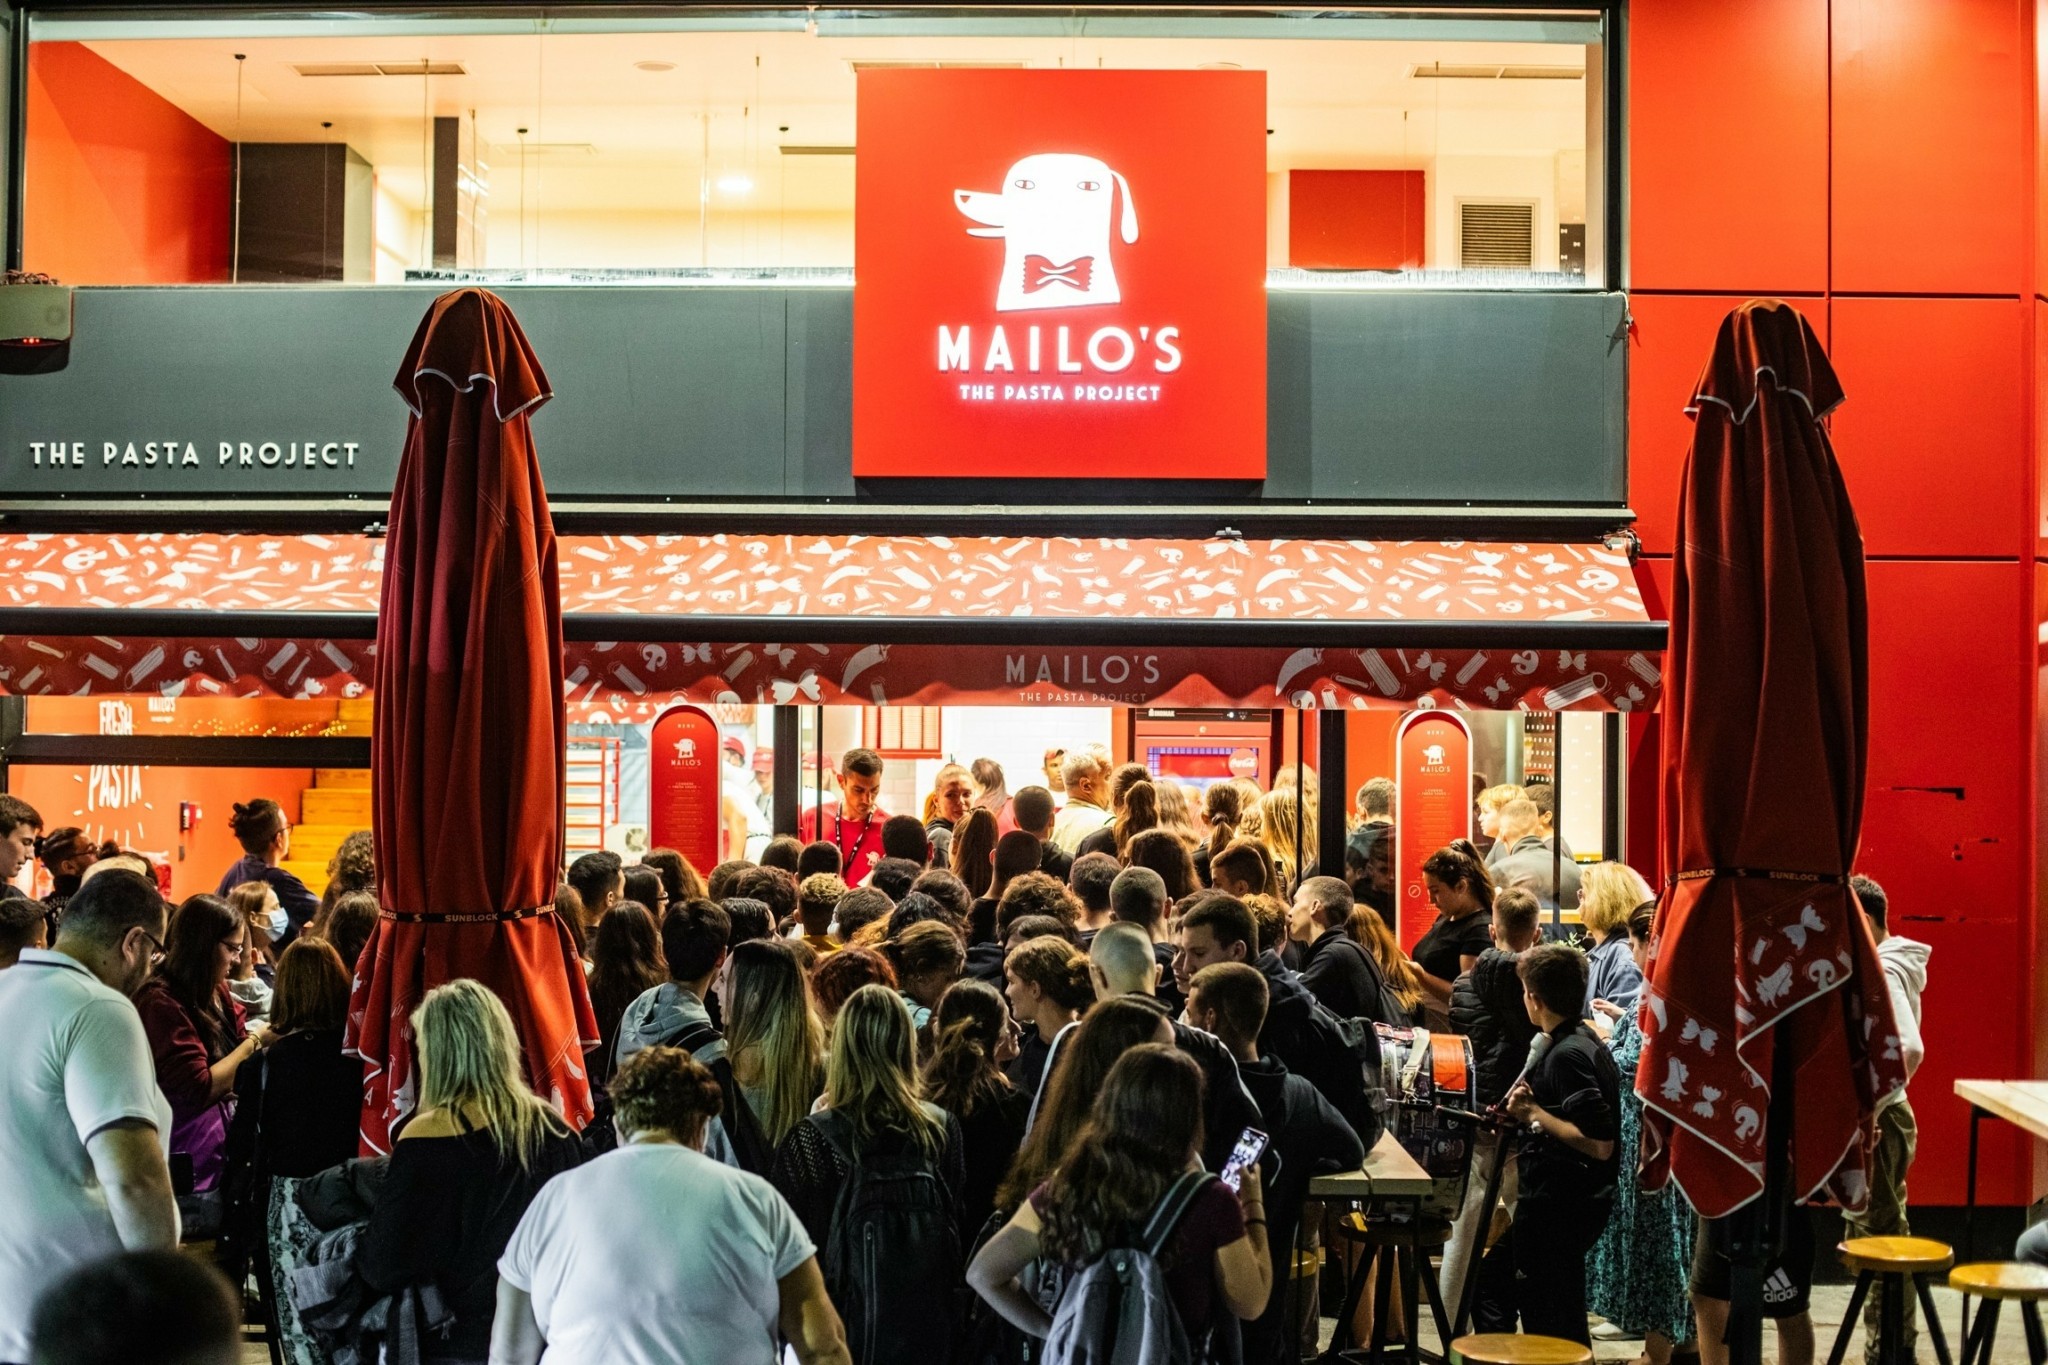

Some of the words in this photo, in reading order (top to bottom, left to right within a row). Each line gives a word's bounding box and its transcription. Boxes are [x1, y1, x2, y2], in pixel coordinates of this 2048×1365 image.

[938, 325, 1182, 373] MAILO'S
[960, 385, 994, 400] THE
[1004, 385, 1065, 400] PASTA
[1074, 386, 1161, 401] PROJECT
[29, 442, 85, 466] THE
[103, 442, 200, 466] PASTA
[218, 442, 360, 466] PROJECT
[1005, 654, 1160, 684] MAILO'S
[1019, 692, 1041, 702] THE
[1048, 692, 1086, 702] PASTA
[1092, 692, 1147, 702] PROJECT
[1677, 868, 1716, 880] SUNBLOCK
[1769, 871, 1820, 882] SUNBLOCK
[445, 912, 498, 923] SUNBLOCK
[1763, 1286, 1798, 1302] adidas
